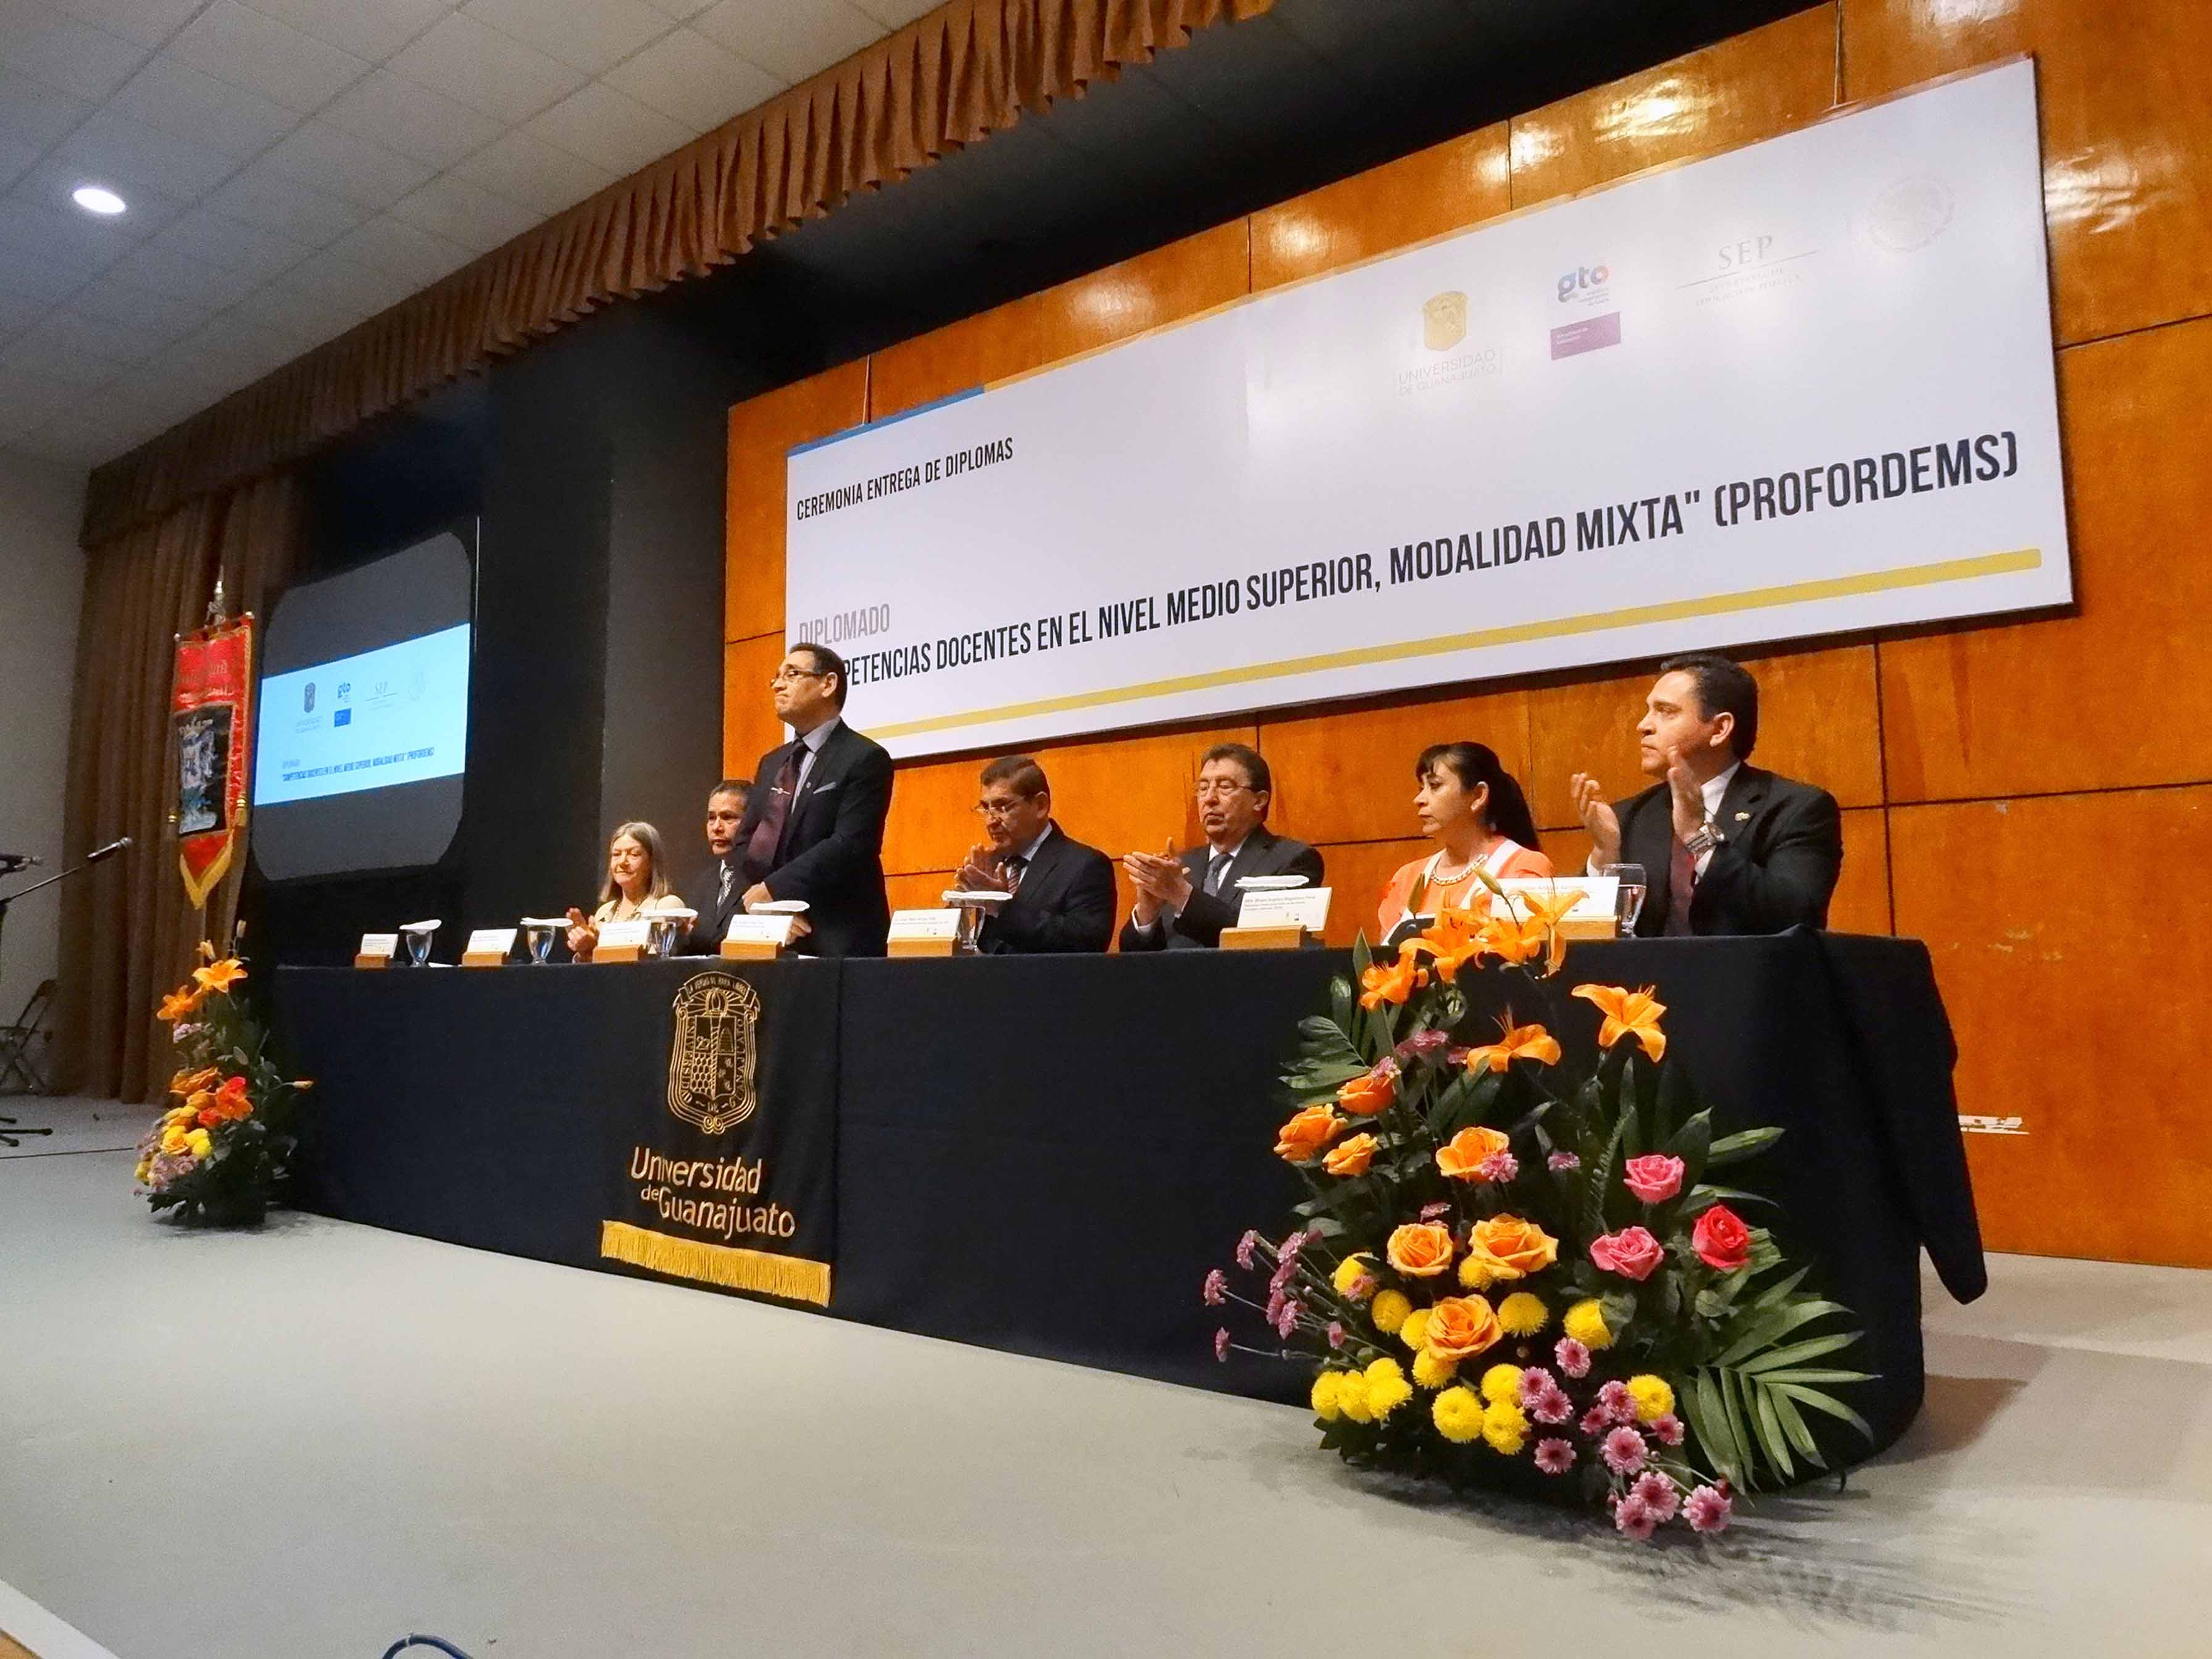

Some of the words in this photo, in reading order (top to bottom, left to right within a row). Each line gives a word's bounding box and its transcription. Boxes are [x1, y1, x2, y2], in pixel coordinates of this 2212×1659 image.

[1719, 235, 1773, 270] SEP
[1558, 265, 1609, 303] gto
[1398, 349, 1496, 384] UNIVERSIDAD
[1398, 384, 1413, 396] DE
[797, 483, 863, 520] CEREMONIA
[867, 466, 920, 500] ENTREGA
[925, 459, 941, 483] DE
[946, 437, 1013, 477] DIPLOMAS
[843, 643, 931, 686] PETENCIAS
[937, 622, 1031, 670] DOCENTES
[1038, 615, 1062, 651] EN
[1069, 611, 1093, 645] EL
[1099, 596, 1161, 640] NIVEL
[1167, 579, 1240, 626] MEDIO
[1246, 553, 1380, 610] SUPERIOR,
[1390, 517, 1566, 585] MODALIDAD
[1576, 490, 1700, 552] MIXTA"
[1714, 431, 2018, 527] (PROFORDEMS)
[799, 603, 890, 645] DIPLOMADO
[631, 1147, 762, 1194] Universidad
[641, 1184, 659, 1200] de
[658, 1186, 796, 1240] Guanajuato
